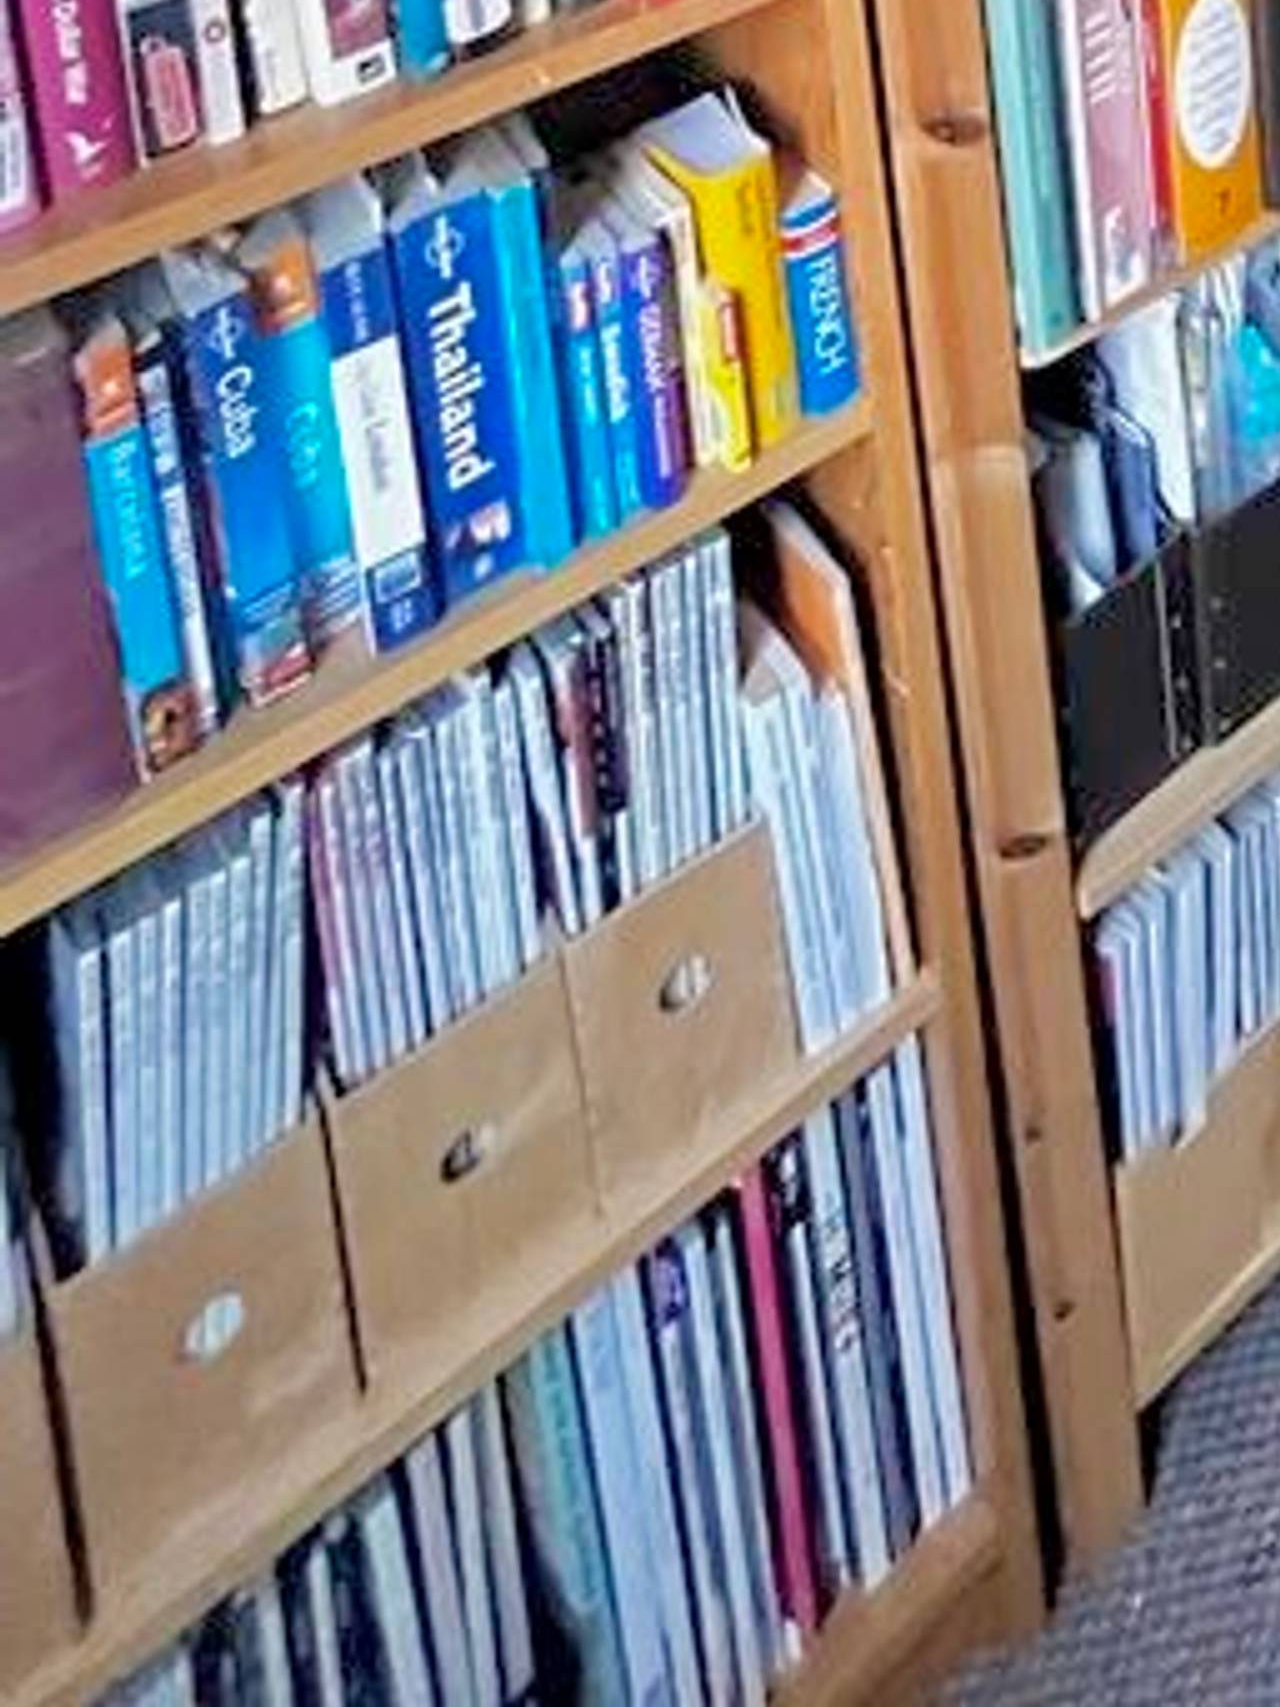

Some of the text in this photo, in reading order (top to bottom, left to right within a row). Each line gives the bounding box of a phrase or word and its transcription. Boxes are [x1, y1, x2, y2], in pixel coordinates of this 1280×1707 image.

[51, 1, 85, 62] Dollar
[61, 66, 91, 104] War
[803, 251, 851, 377] FRENCH
[213, 364, 260, 459] Cuba
[427, 281, 497, 492] Thailand
[600, 320, 630, 423] Swedish
[105, 439, 154, 579] Barcelona
